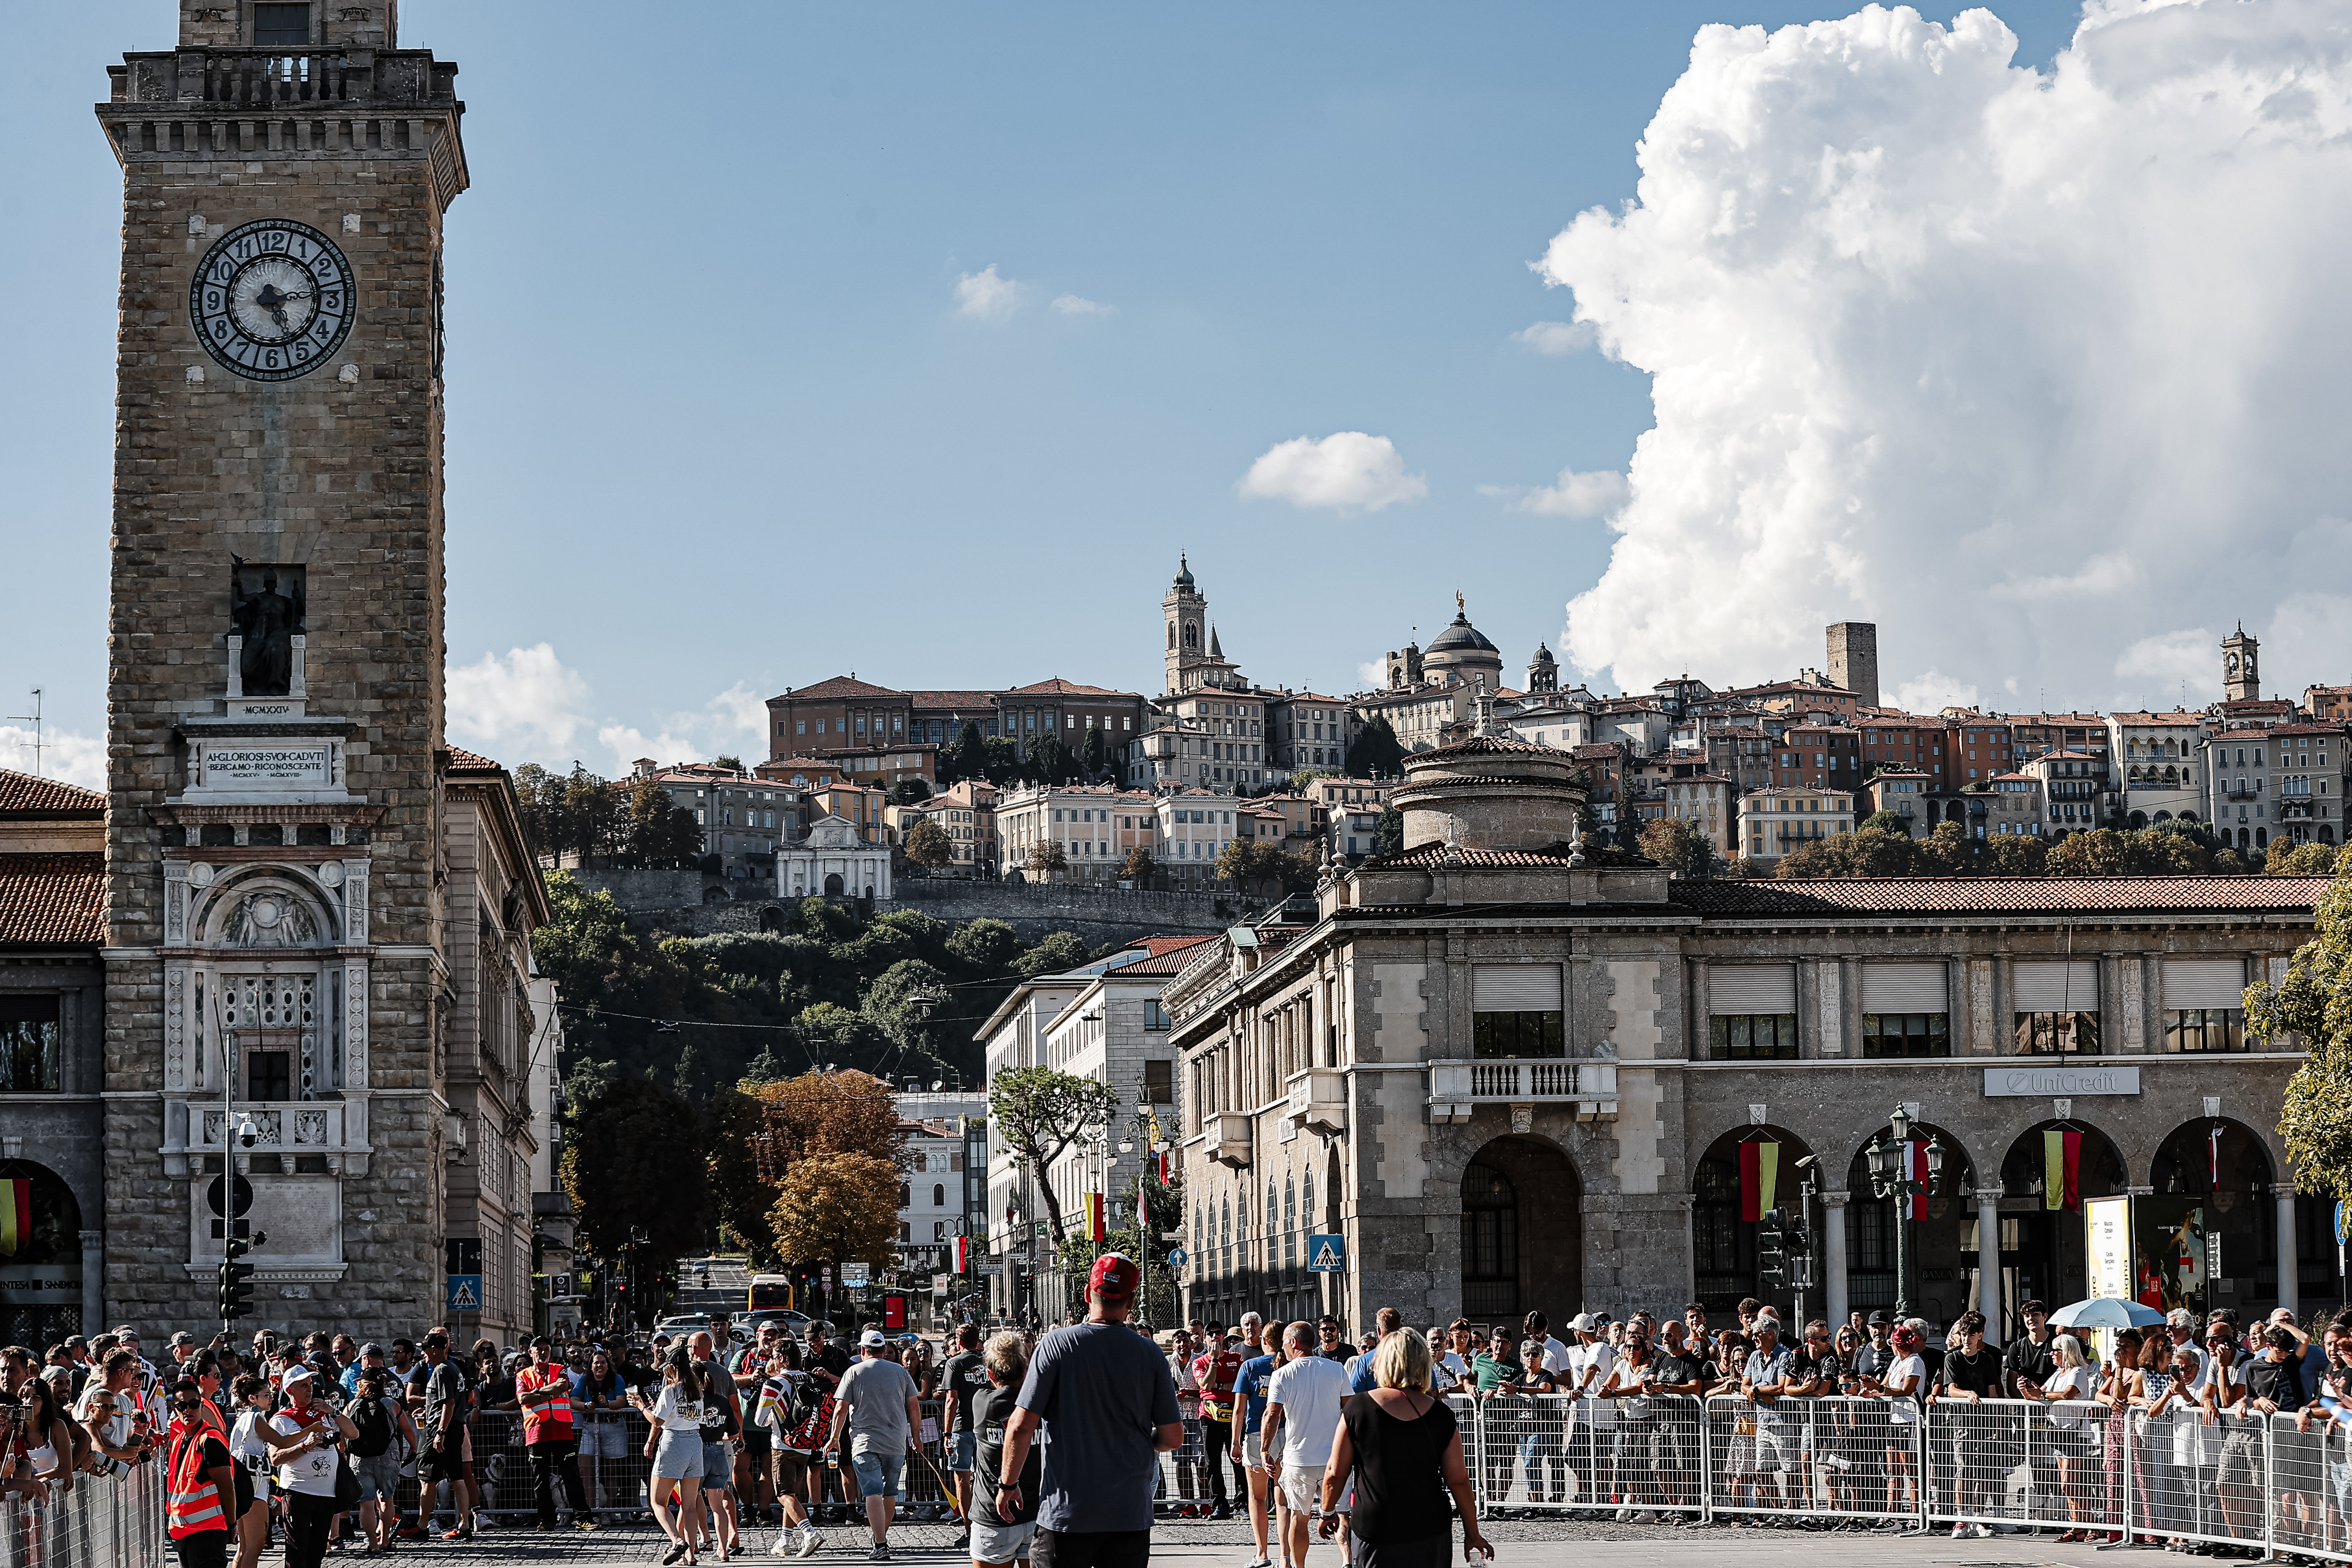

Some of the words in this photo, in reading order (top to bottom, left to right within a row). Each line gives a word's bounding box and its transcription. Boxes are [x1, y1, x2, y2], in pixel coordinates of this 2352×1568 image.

[236, 240, 251, 258] 11
[262, 232, 284, 251] 12
[299, 239, 307, 258] 1
[212, 261, 233, 280] 10
[318, 258, 331, 277] 2
[207, 291, 220, 310] 9
[327, 289, 339, 309] 3
[214, 320, 227, 339] 8
[316, 320, 329, 339] 4
[236, 342, 250, 361] 7
[266, 349, 278, 368] 6
[296, 342, 309, 360] 5
[218, 753, 263, 761] GLORIOSI
[2032, 1072, 2118, 1092] UniCredit
[0, 1280, 29, 1289] INTESA
[805, 1406, 818, 1438] MAXXIS
